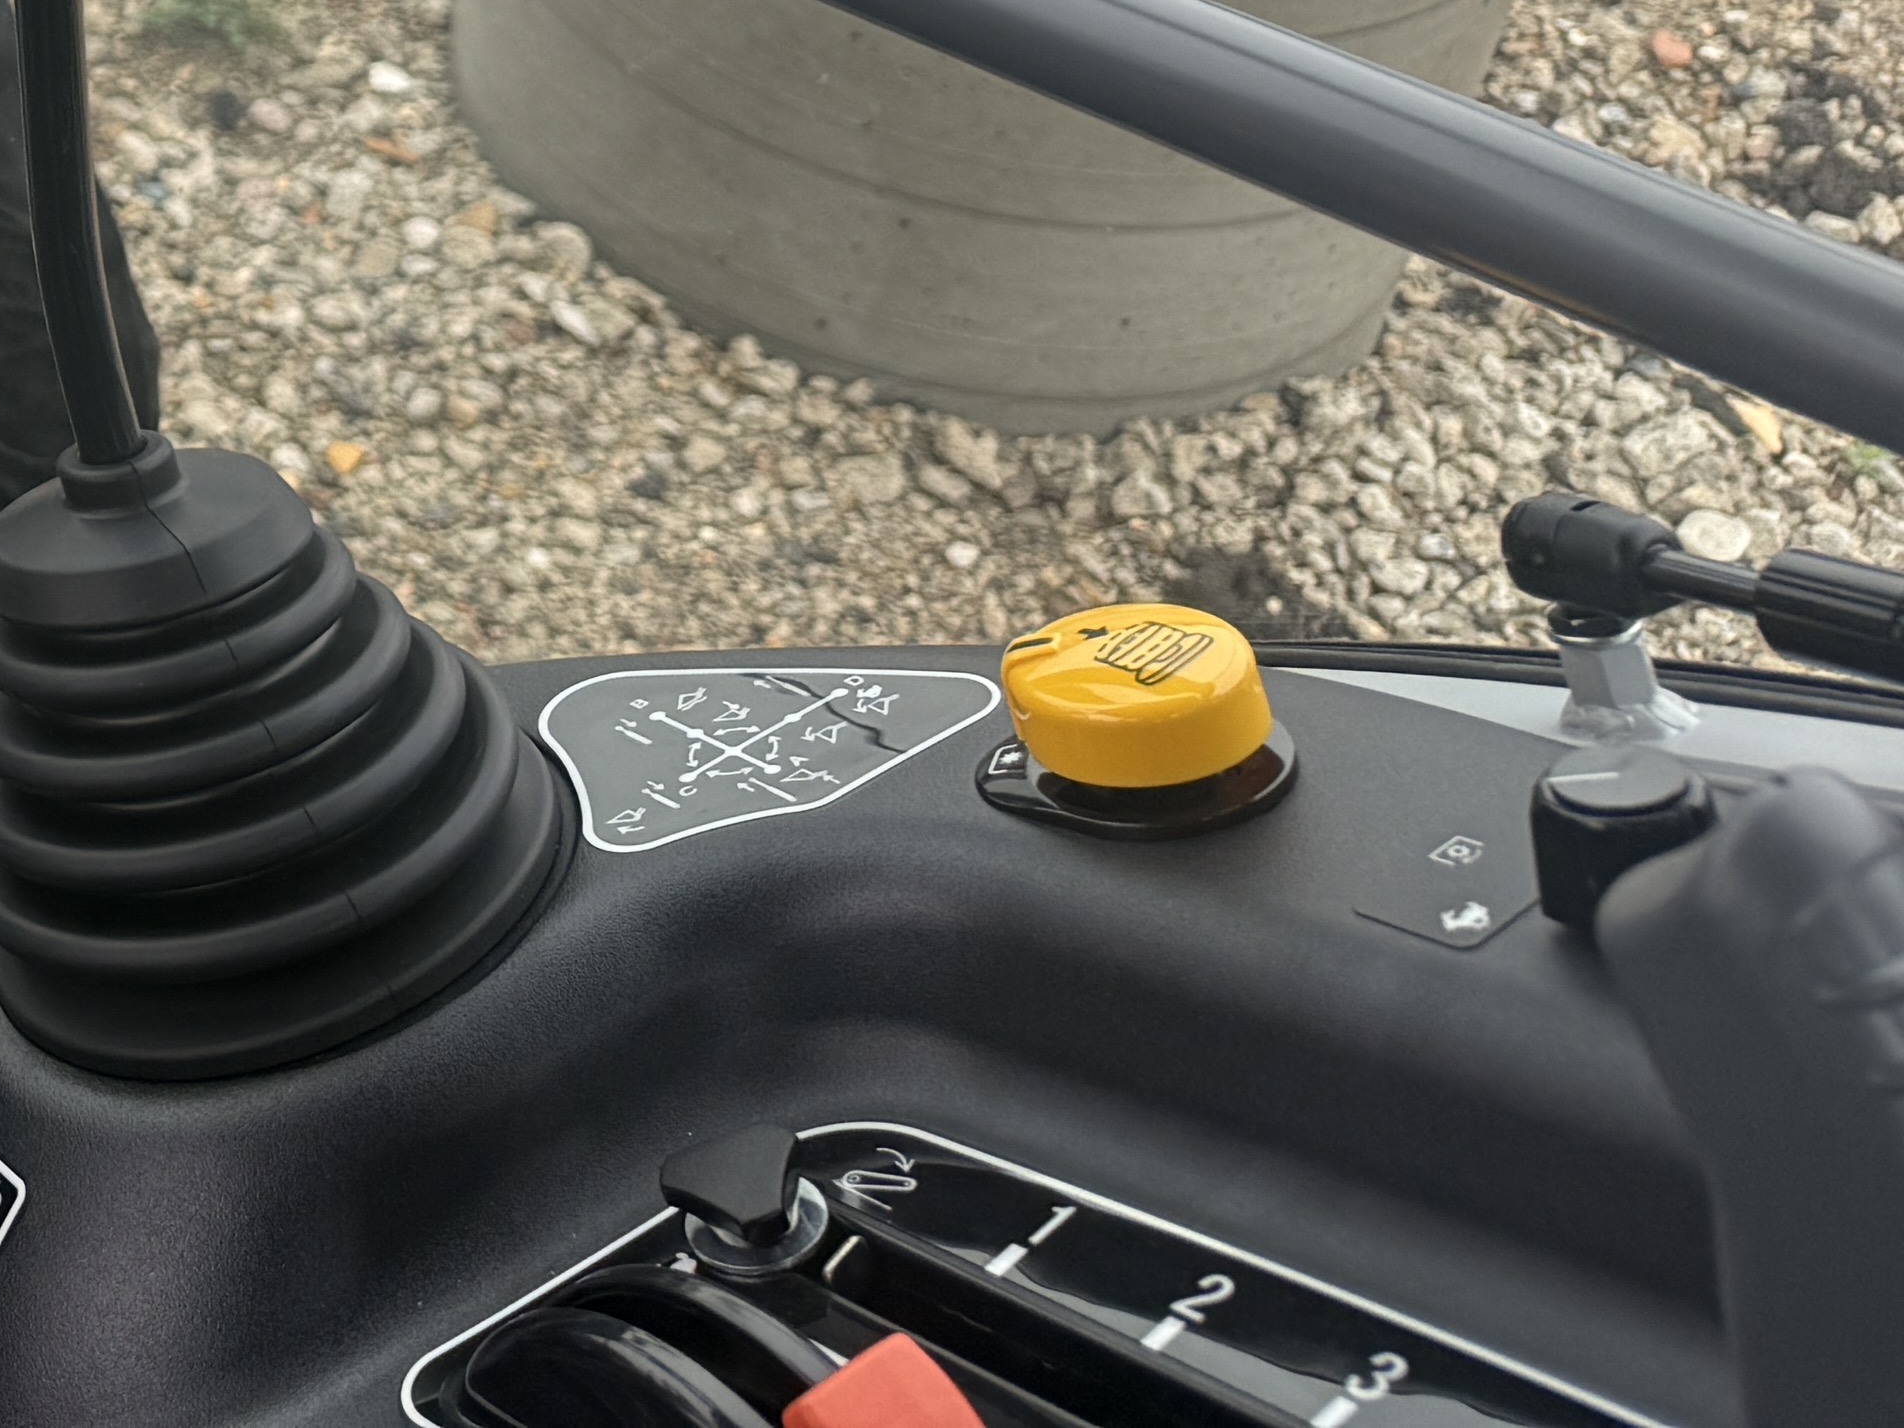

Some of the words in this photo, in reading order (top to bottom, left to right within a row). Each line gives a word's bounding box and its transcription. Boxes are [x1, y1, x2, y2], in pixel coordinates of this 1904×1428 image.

[1028, 1206, 1077, 1245] 1
[1169, 1274, 1236, 1324] 2
[1345, 1352, 1410, 1401] 3
